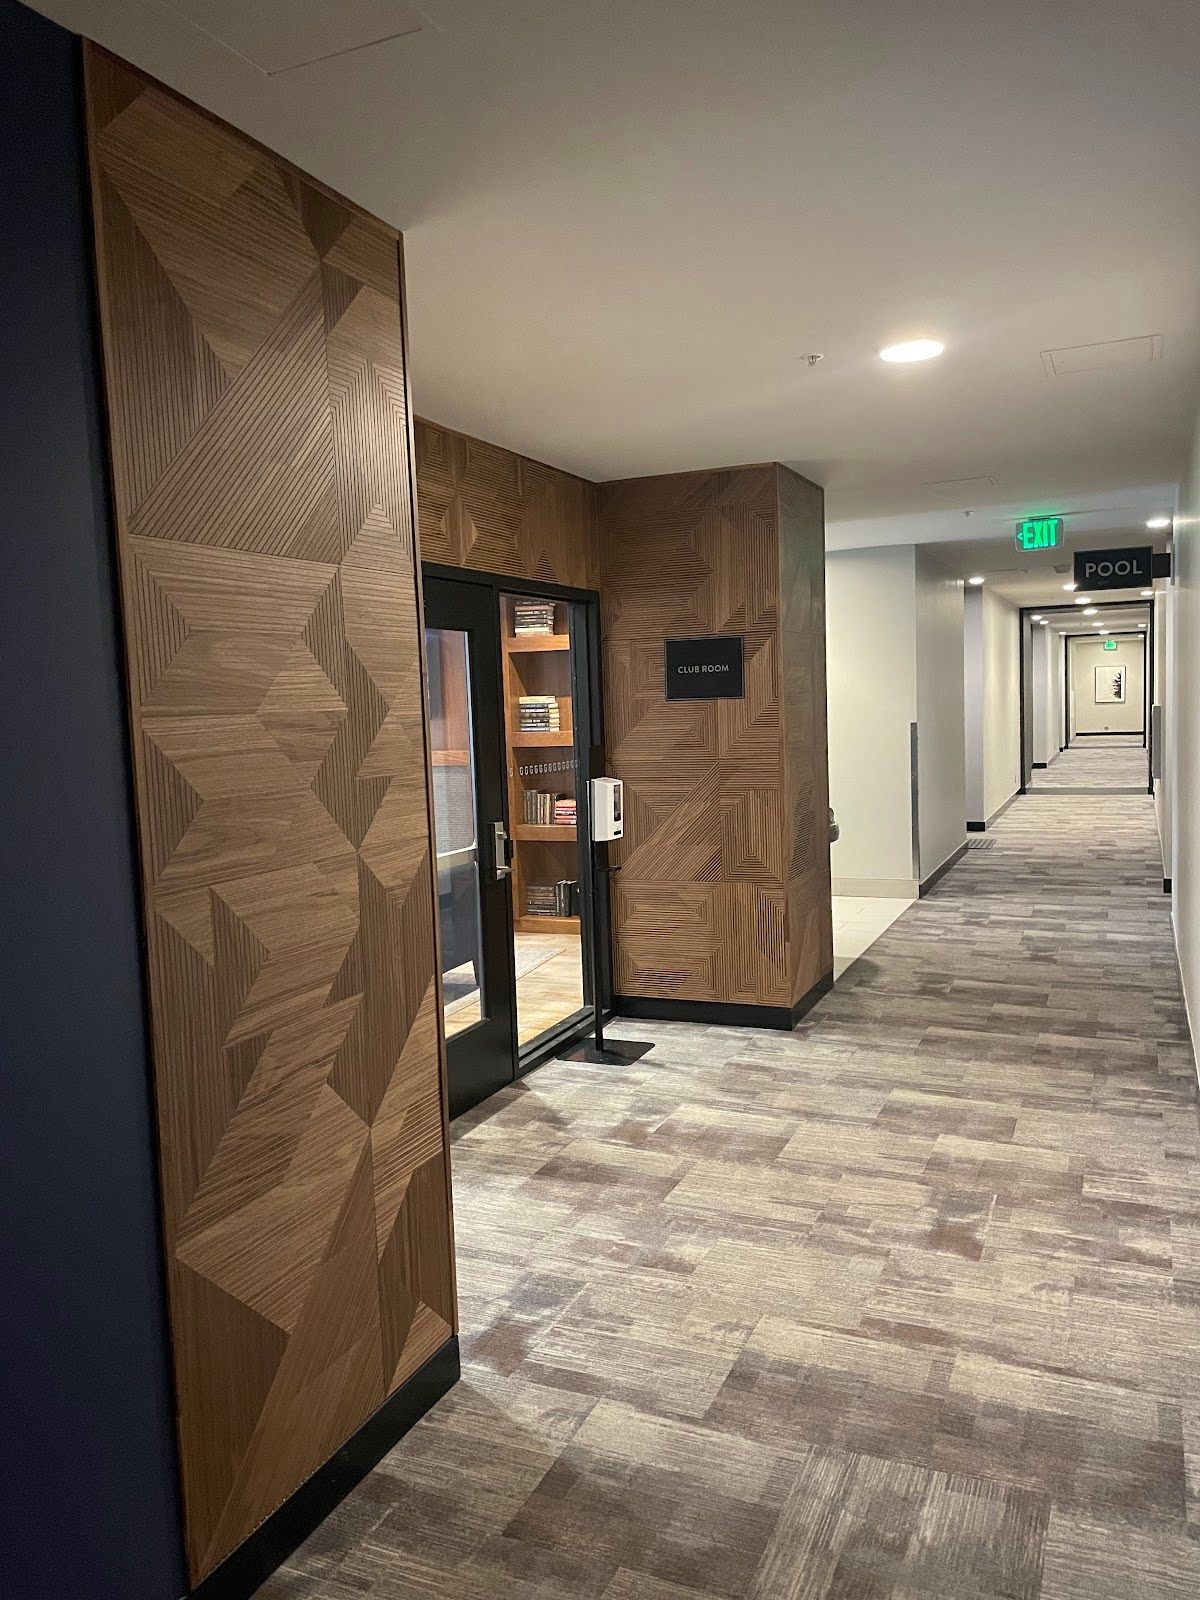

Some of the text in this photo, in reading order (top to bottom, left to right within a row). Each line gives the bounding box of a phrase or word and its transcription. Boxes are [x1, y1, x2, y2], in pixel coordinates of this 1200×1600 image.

[1022, 519, 1058, 549] EXIT
[1085, 559, 1143, 578] POOL
[677, 664, 730, 674] CLUB ROOM
